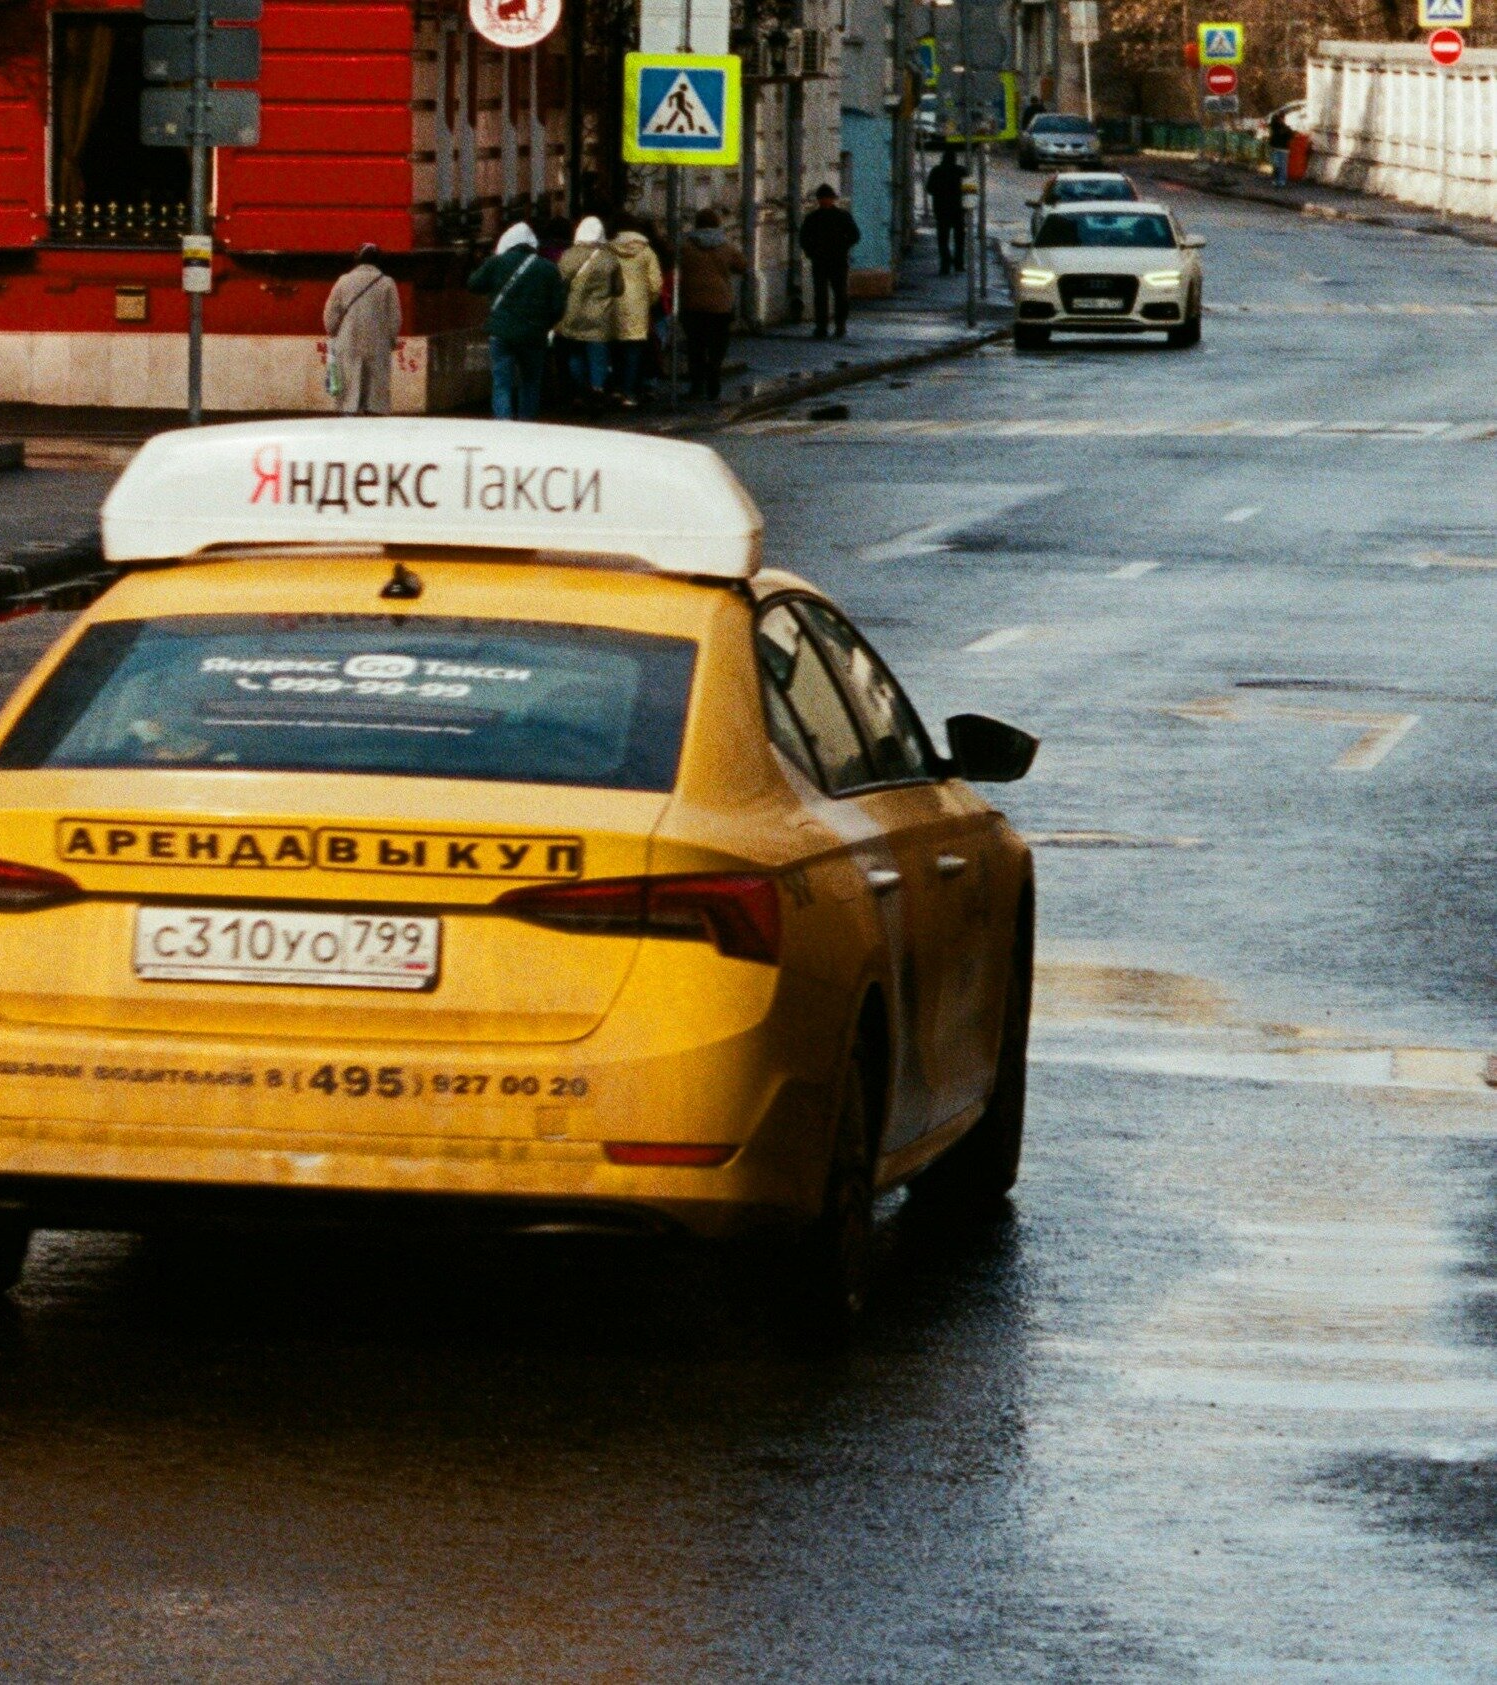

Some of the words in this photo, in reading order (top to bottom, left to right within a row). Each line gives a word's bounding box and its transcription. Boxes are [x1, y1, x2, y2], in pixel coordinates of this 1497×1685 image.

[249, 442, 440, 515] Яндекс
[456, 444, 603, 514] Такси
[66, 826, 308, 868] АРЕНДА
[326, 833, 581, 873] ВЫКУП
